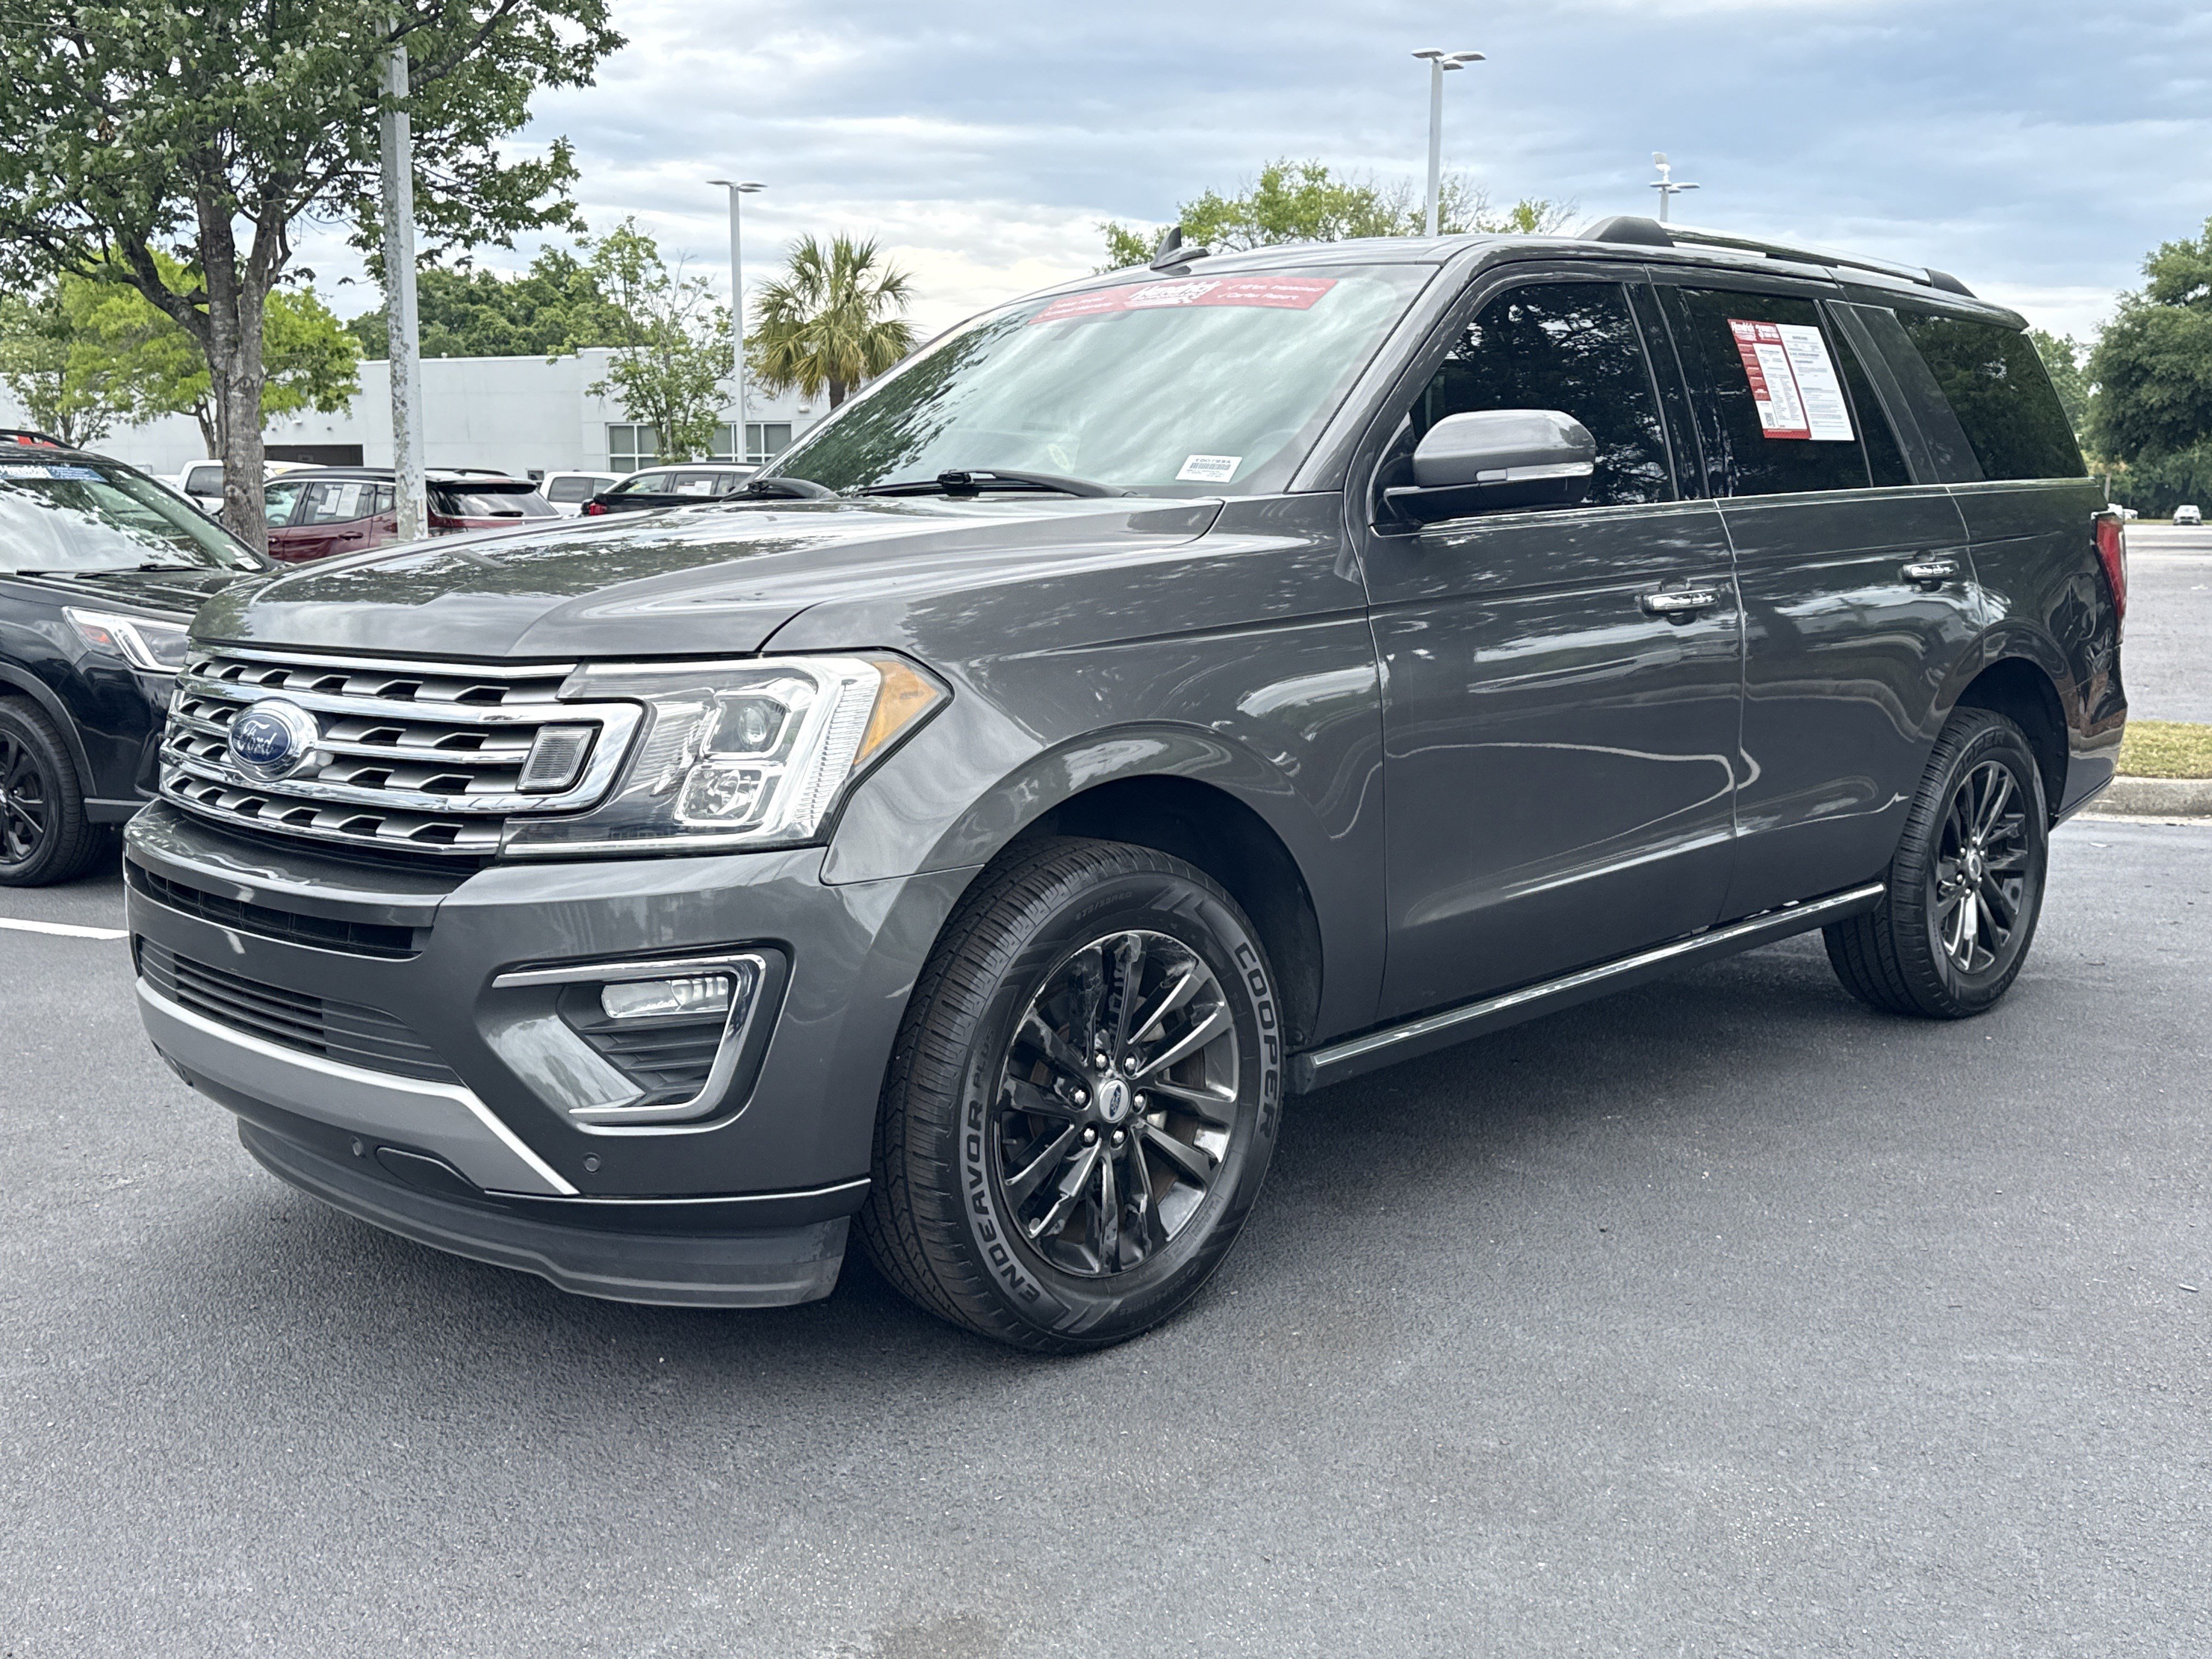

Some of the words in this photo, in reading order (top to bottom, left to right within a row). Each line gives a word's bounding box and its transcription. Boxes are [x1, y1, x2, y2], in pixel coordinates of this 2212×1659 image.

[234, 720, 278, 756] Ford
[1223, 941, 1278, 1138] COOPER
[966, 1099, 1041, 1305] ENDEAVOR
